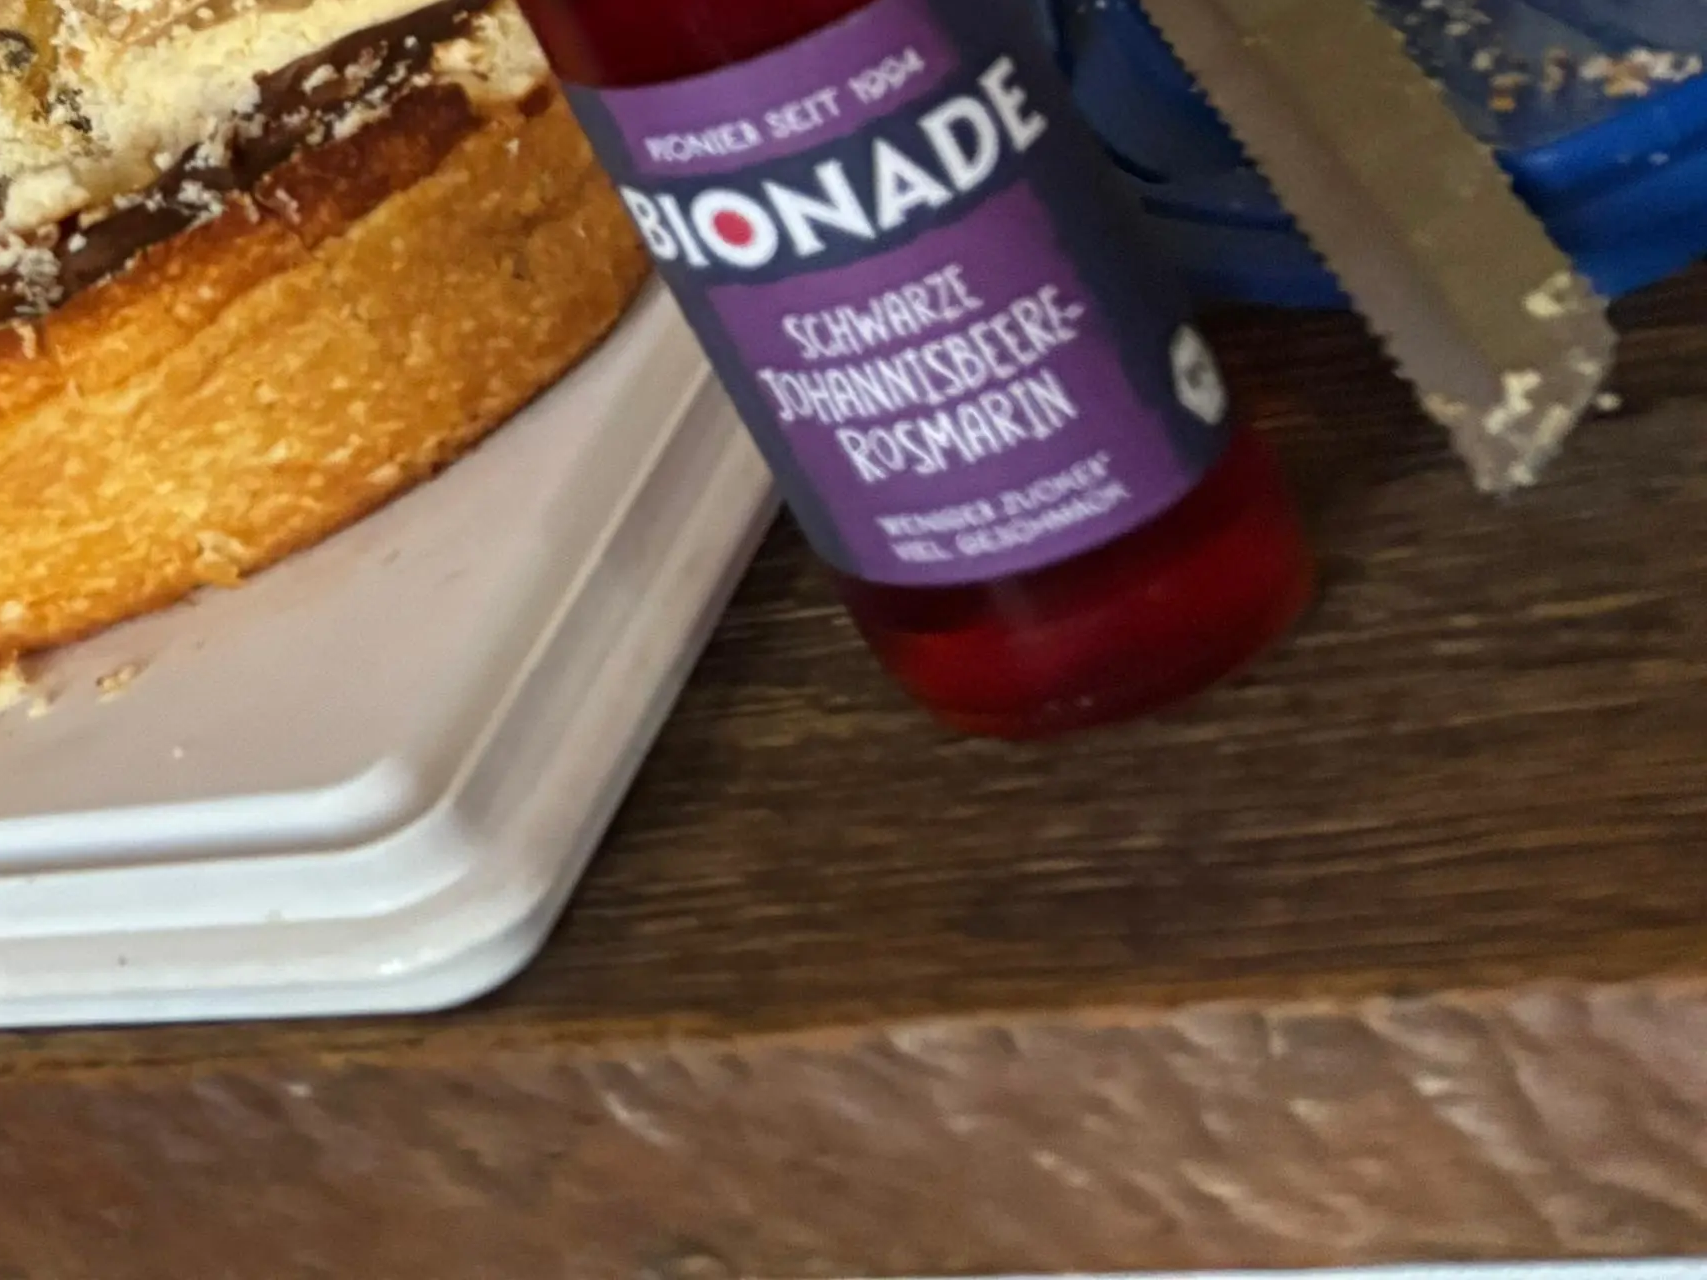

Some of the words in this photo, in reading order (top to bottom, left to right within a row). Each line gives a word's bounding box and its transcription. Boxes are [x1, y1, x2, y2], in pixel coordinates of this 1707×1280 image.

[618, 54, 1049, 269] BIONADE
[763, 85, 843, 140] SEIT
[782, 263, 984, 360] SCHWARZE
[835, 369, 1079, 484] ROSMARIN
